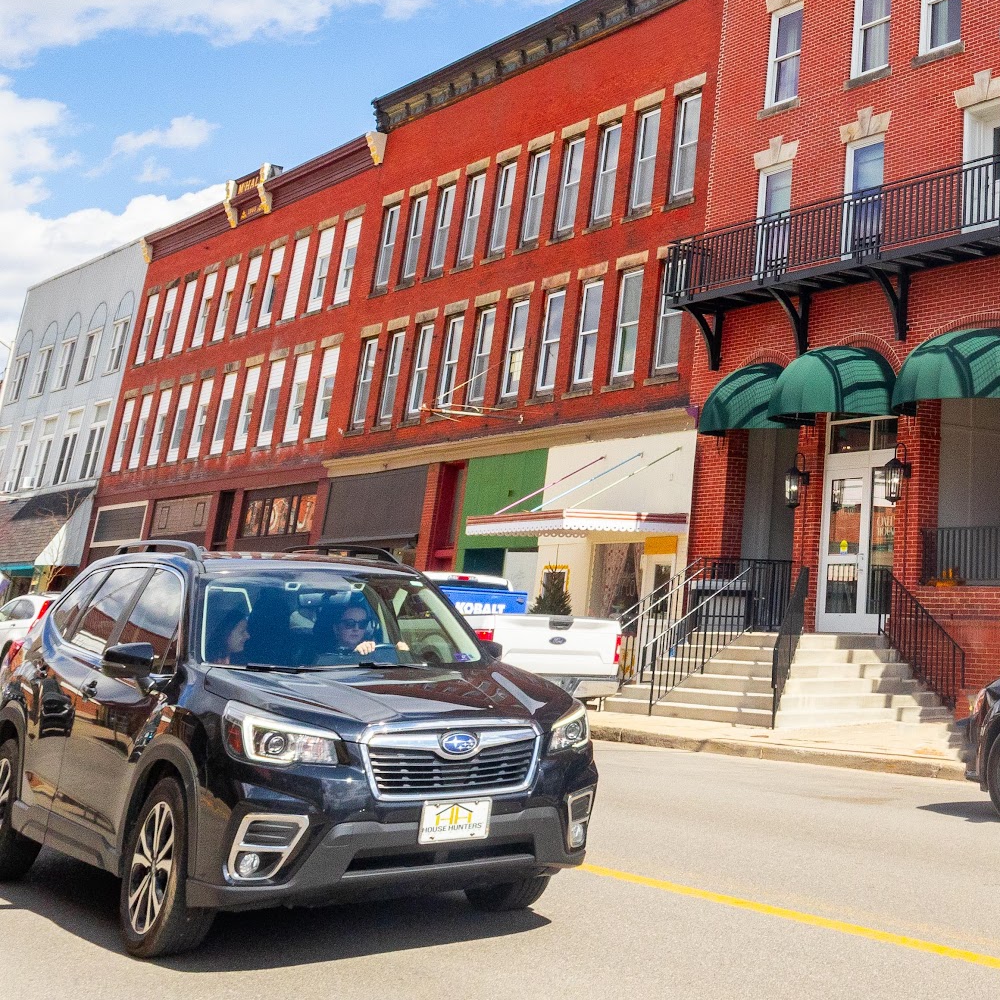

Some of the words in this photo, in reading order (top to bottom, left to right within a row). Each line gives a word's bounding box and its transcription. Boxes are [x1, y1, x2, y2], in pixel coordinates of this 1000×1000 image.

[454, 601, 506, 615] KOBALT
[421, 825, 447, 833] HOUSE
[447, 822, 483, 832] HUNTERS
